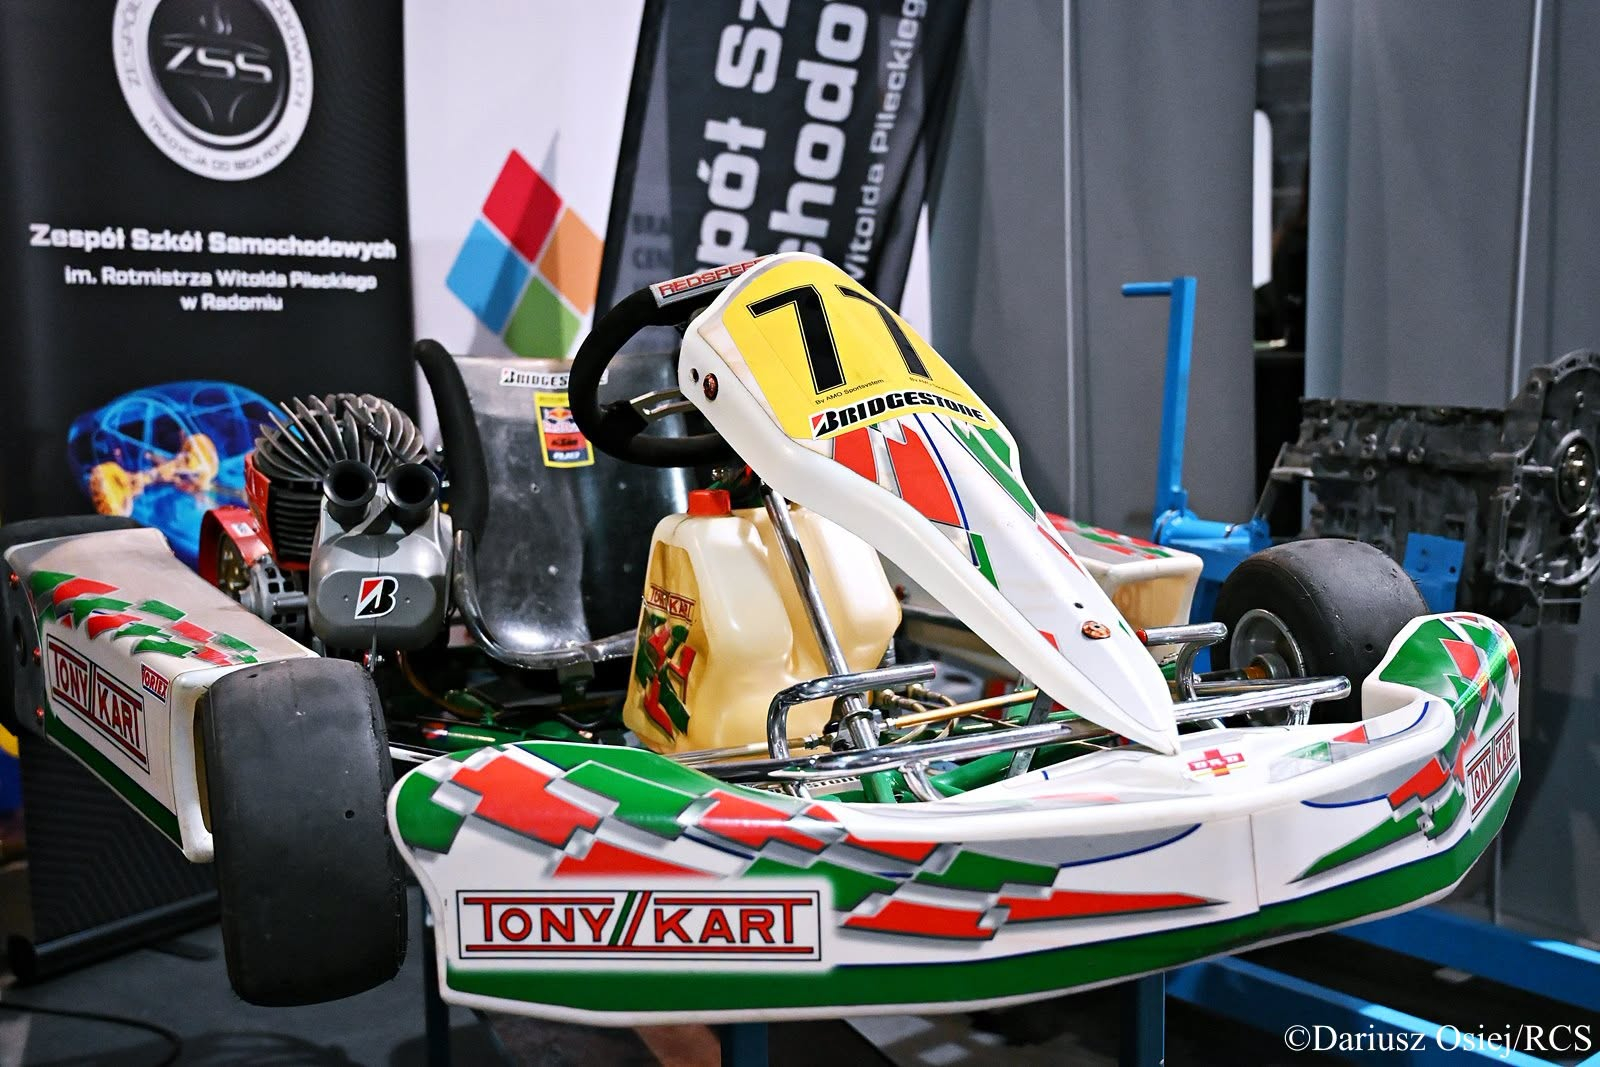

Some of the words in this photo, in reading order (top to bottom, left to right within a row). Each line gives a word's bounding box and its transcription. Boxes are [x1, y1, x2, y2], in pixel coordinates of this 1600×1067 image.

[768, 0, 868, 253] hodo
[694, 117, 767, 273] pół
[29, 223, 126, 252] Zespół
[131, 228, 203, 253] Szkół
[208, 231, 397, 262] Samochodowych
[64, 265, 98, 284] im.
[101, 266, 213, 287] Rotmistrza
[215, 269, 288, 288] Witolda
[289, 270, 378, 292] Pileckiego
[659, 258, 766, 296] REDSPEE
[179, 296, 198, 310] w
[201, 293, 283, 311] Radomiu
[504, 371, 569, 386] BRIDGES
[826, 391, 843, 402] AMO
[812, 392, 986, 437] BRIDGESTONE
[49, 641, 88, 707] TONY
[97, 672, 142, 750] KART
[1468, 747, 1491, 804] TONY
[1496, 719, 1515, 775] KART
[464, 897, 615, 943] TONY
[654, 897, 812, 944] KART
